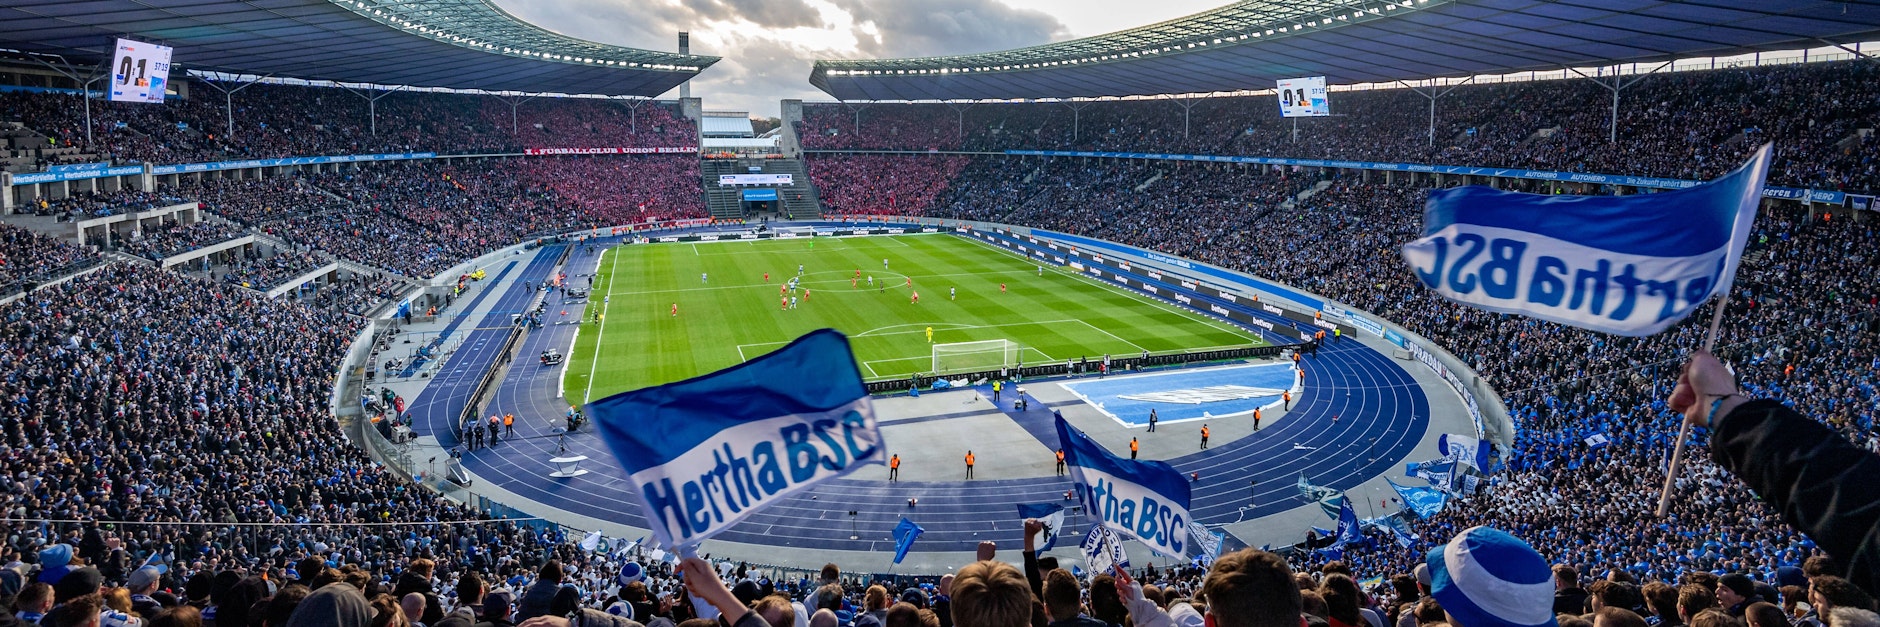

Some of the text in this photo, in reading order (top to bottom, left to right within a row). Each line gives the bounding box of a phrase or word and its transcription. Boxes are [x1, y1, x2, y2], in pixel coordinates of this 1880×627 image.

[1525, 171, 1557, 179] AUTOHERO
[1571, 174, 1606, 182] AUTOHERO
[1636, 178, 1659, 186] Zukunft
[1660, 180, 1680, 188] gehört
[1115, 274, 1128, 284] betway
[1143, 283, 1157, 294] betway
[1181, 280, 1196, 291] betway
[1175, 293, 1191, 305] betway
[1219, 291, 1237, 303] betway
[1211, 303, 1230, 317] betway
[1263, 303, 1283, 317] betway
[1253, 316, 1274, 331] betway
[1314, 318, 1337, 332] betway
[643, 410, 876, 541] Hertha BSC
[1137, 497, 1183, 553] BSC
